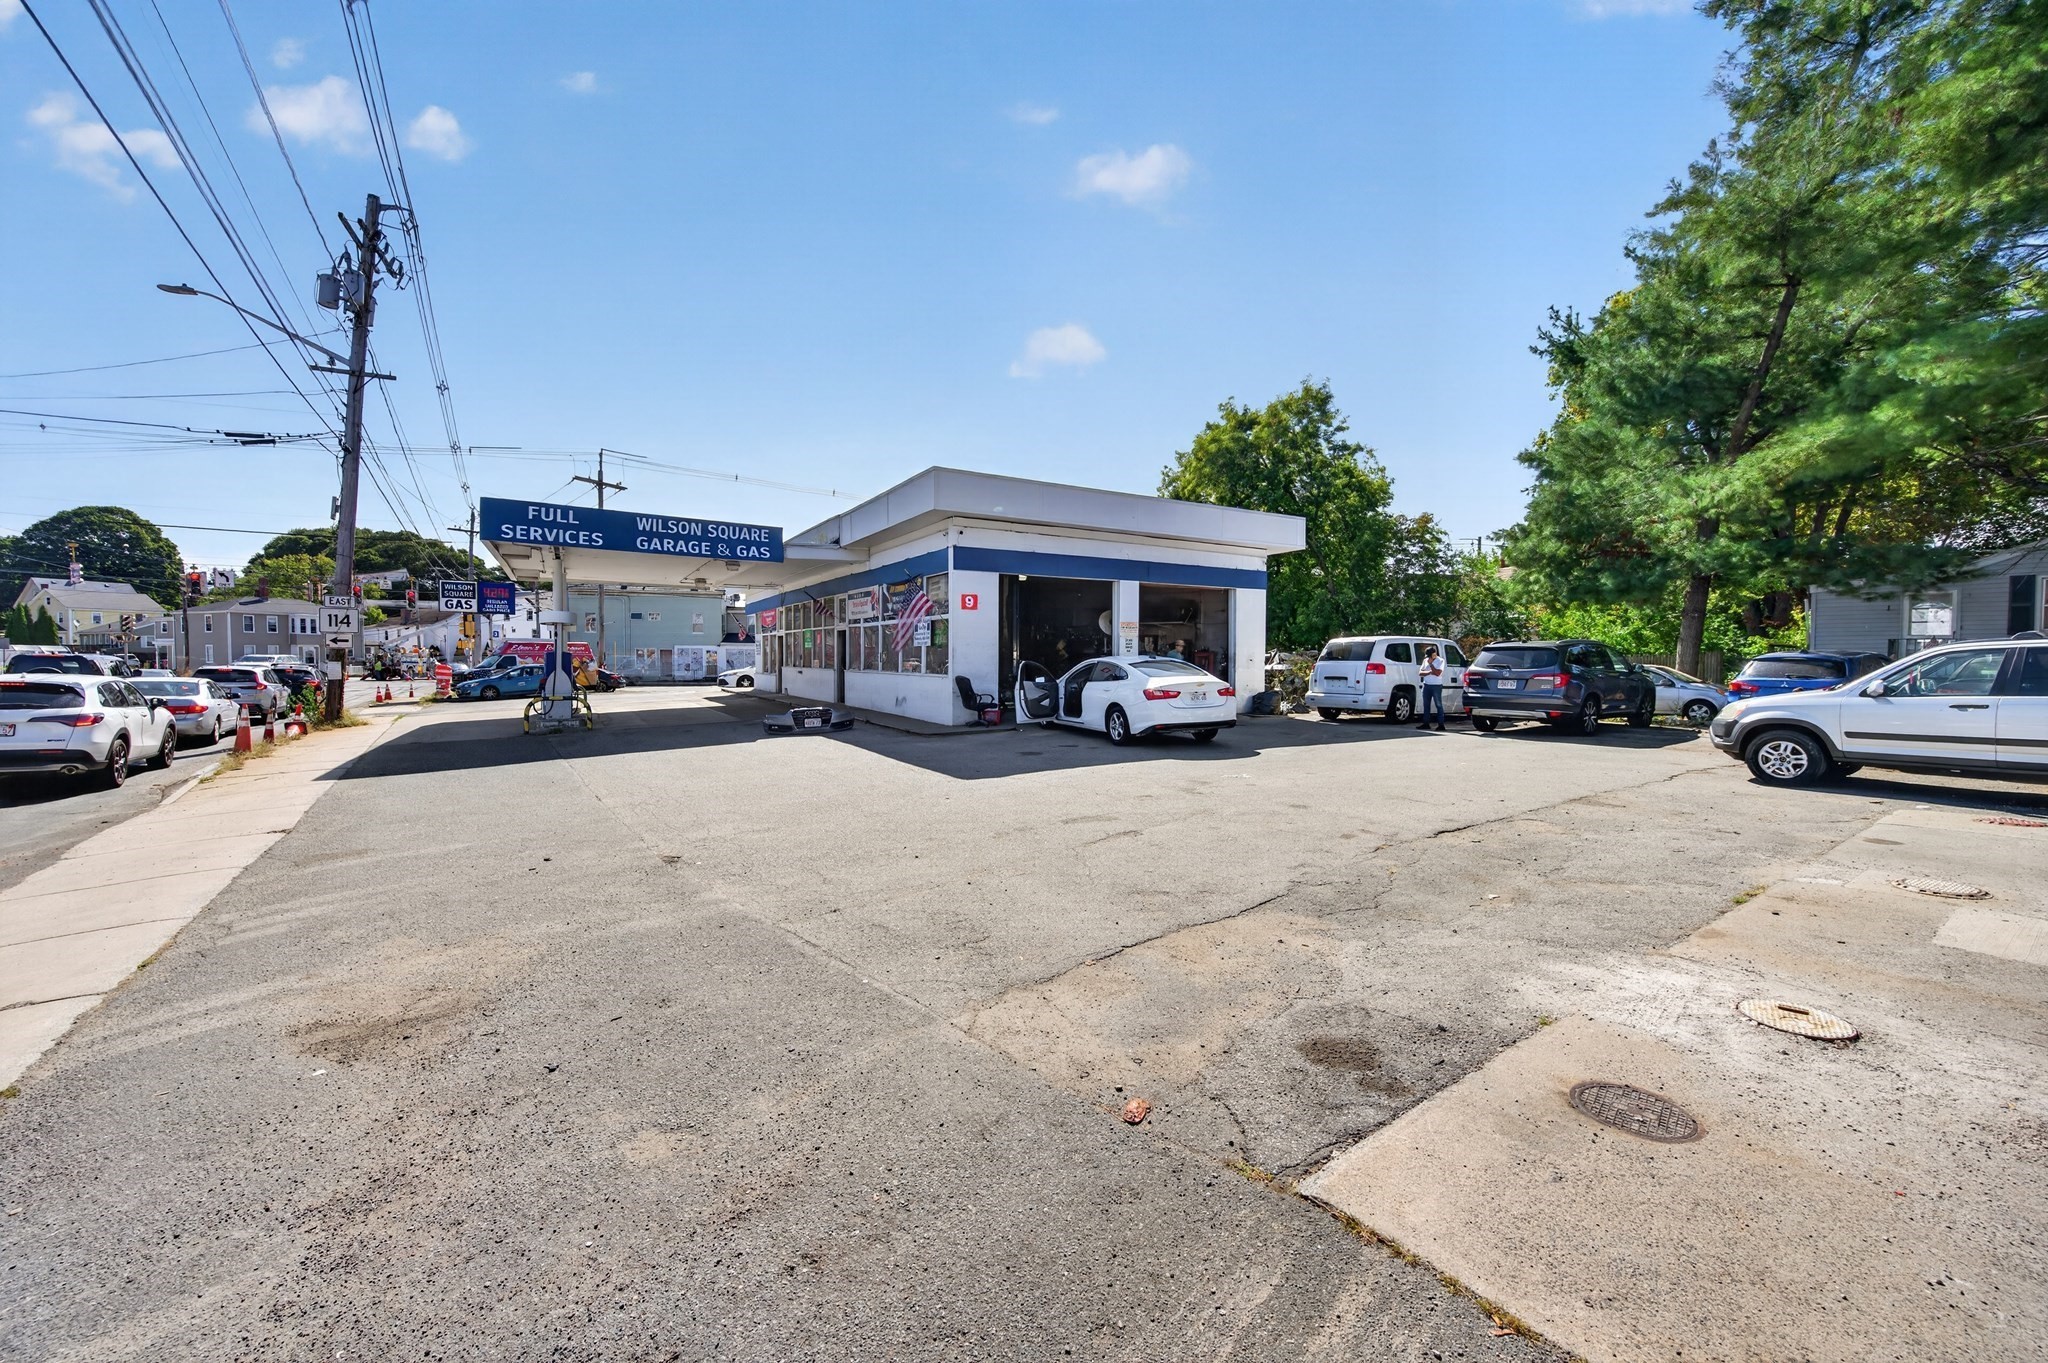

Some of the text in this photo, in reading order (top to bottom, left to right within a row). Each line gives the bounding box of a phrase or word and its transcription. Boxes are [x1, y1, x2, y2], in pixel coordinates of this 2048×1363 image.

[528, 506, 579, 524] FULL
[501, 524, 603, 546] SERVICES
[636, 516, 769, 542] WILSON SQUARE
[636, 536, 770, 558] GARAGE & GAS
[329, 597, 351, 605] EAST
[445, 599, 473, 609] GAS
[965, 596, 974, 607] 9
[327, 614, 351, 627] 114
